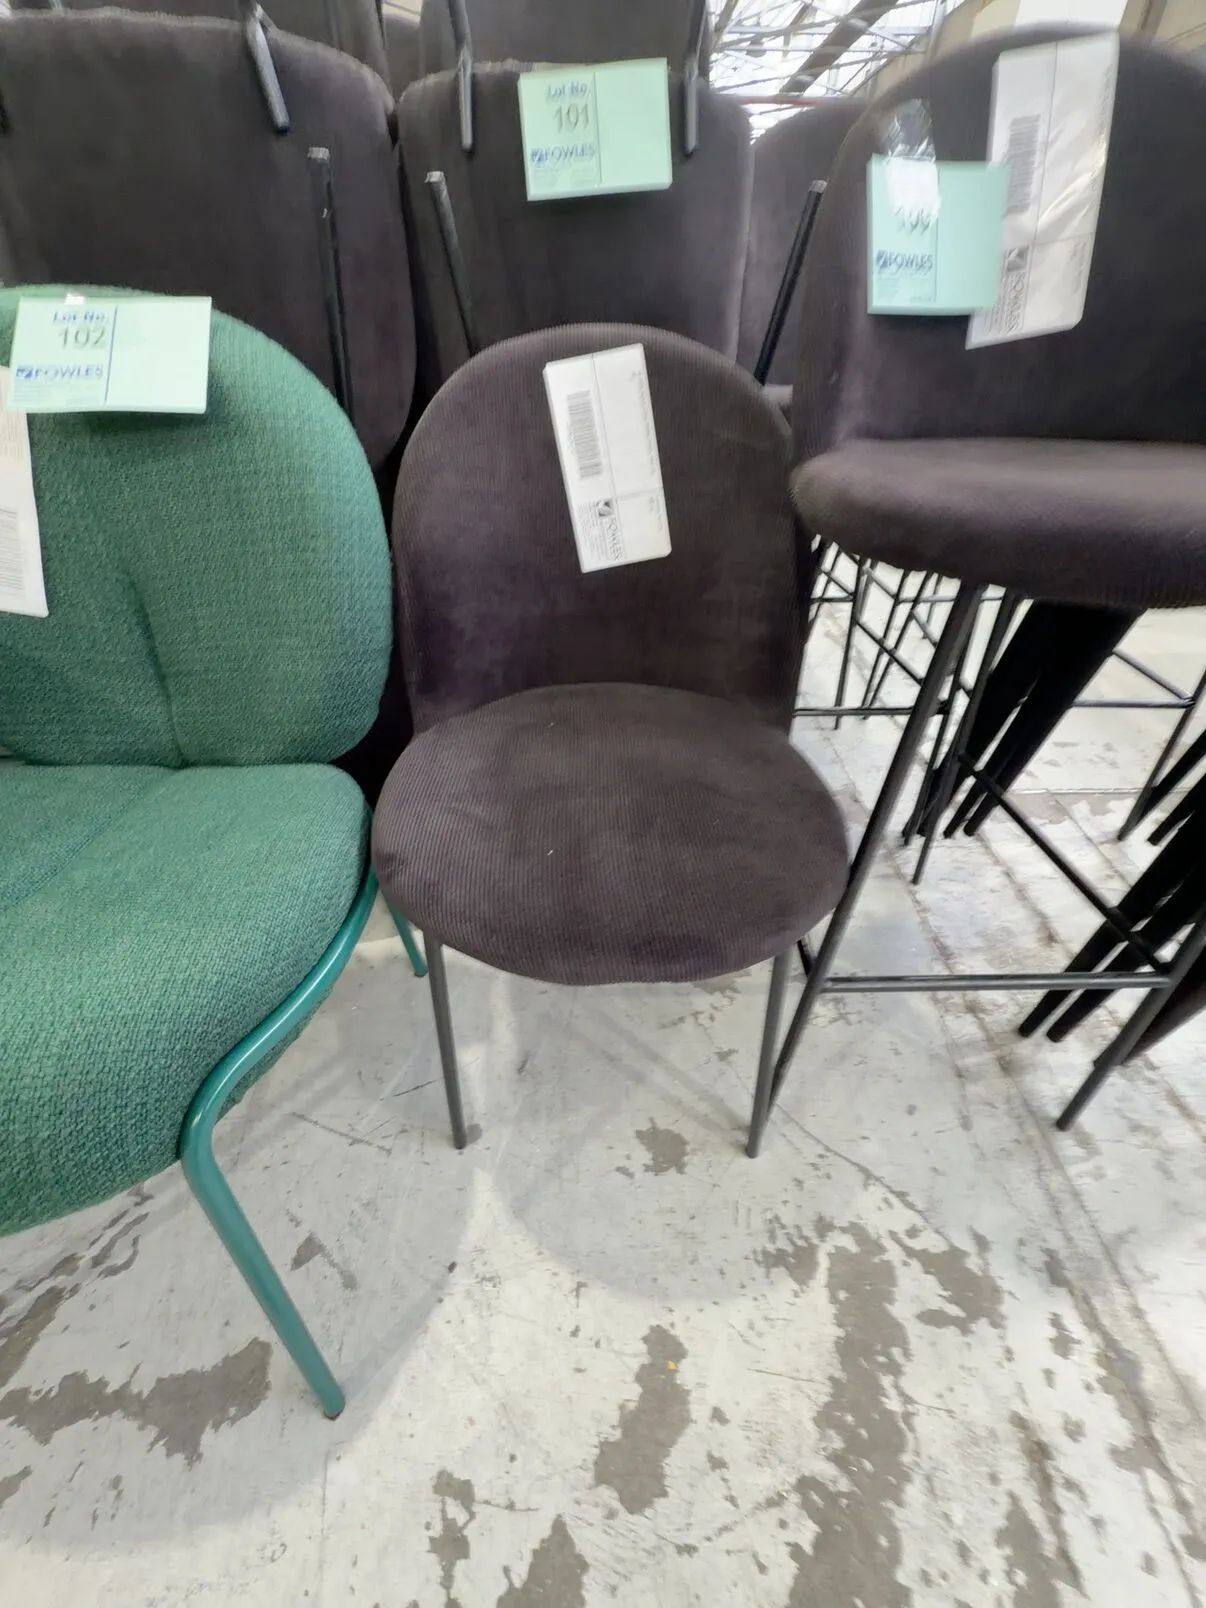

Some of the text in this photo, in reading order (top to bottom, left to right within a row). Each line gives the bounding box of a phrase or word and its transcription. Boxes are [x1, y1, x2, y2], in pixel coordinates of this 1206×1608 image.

[547, 83, 566, 98] Lot
[553, 102, 589, 132] 101
[543, 143, 596, 162] FOWLES
[53, 310, 77, 323] Lot
[58, 326, 106, 350] 102
[34, 364, 104, 380] FOWLES
